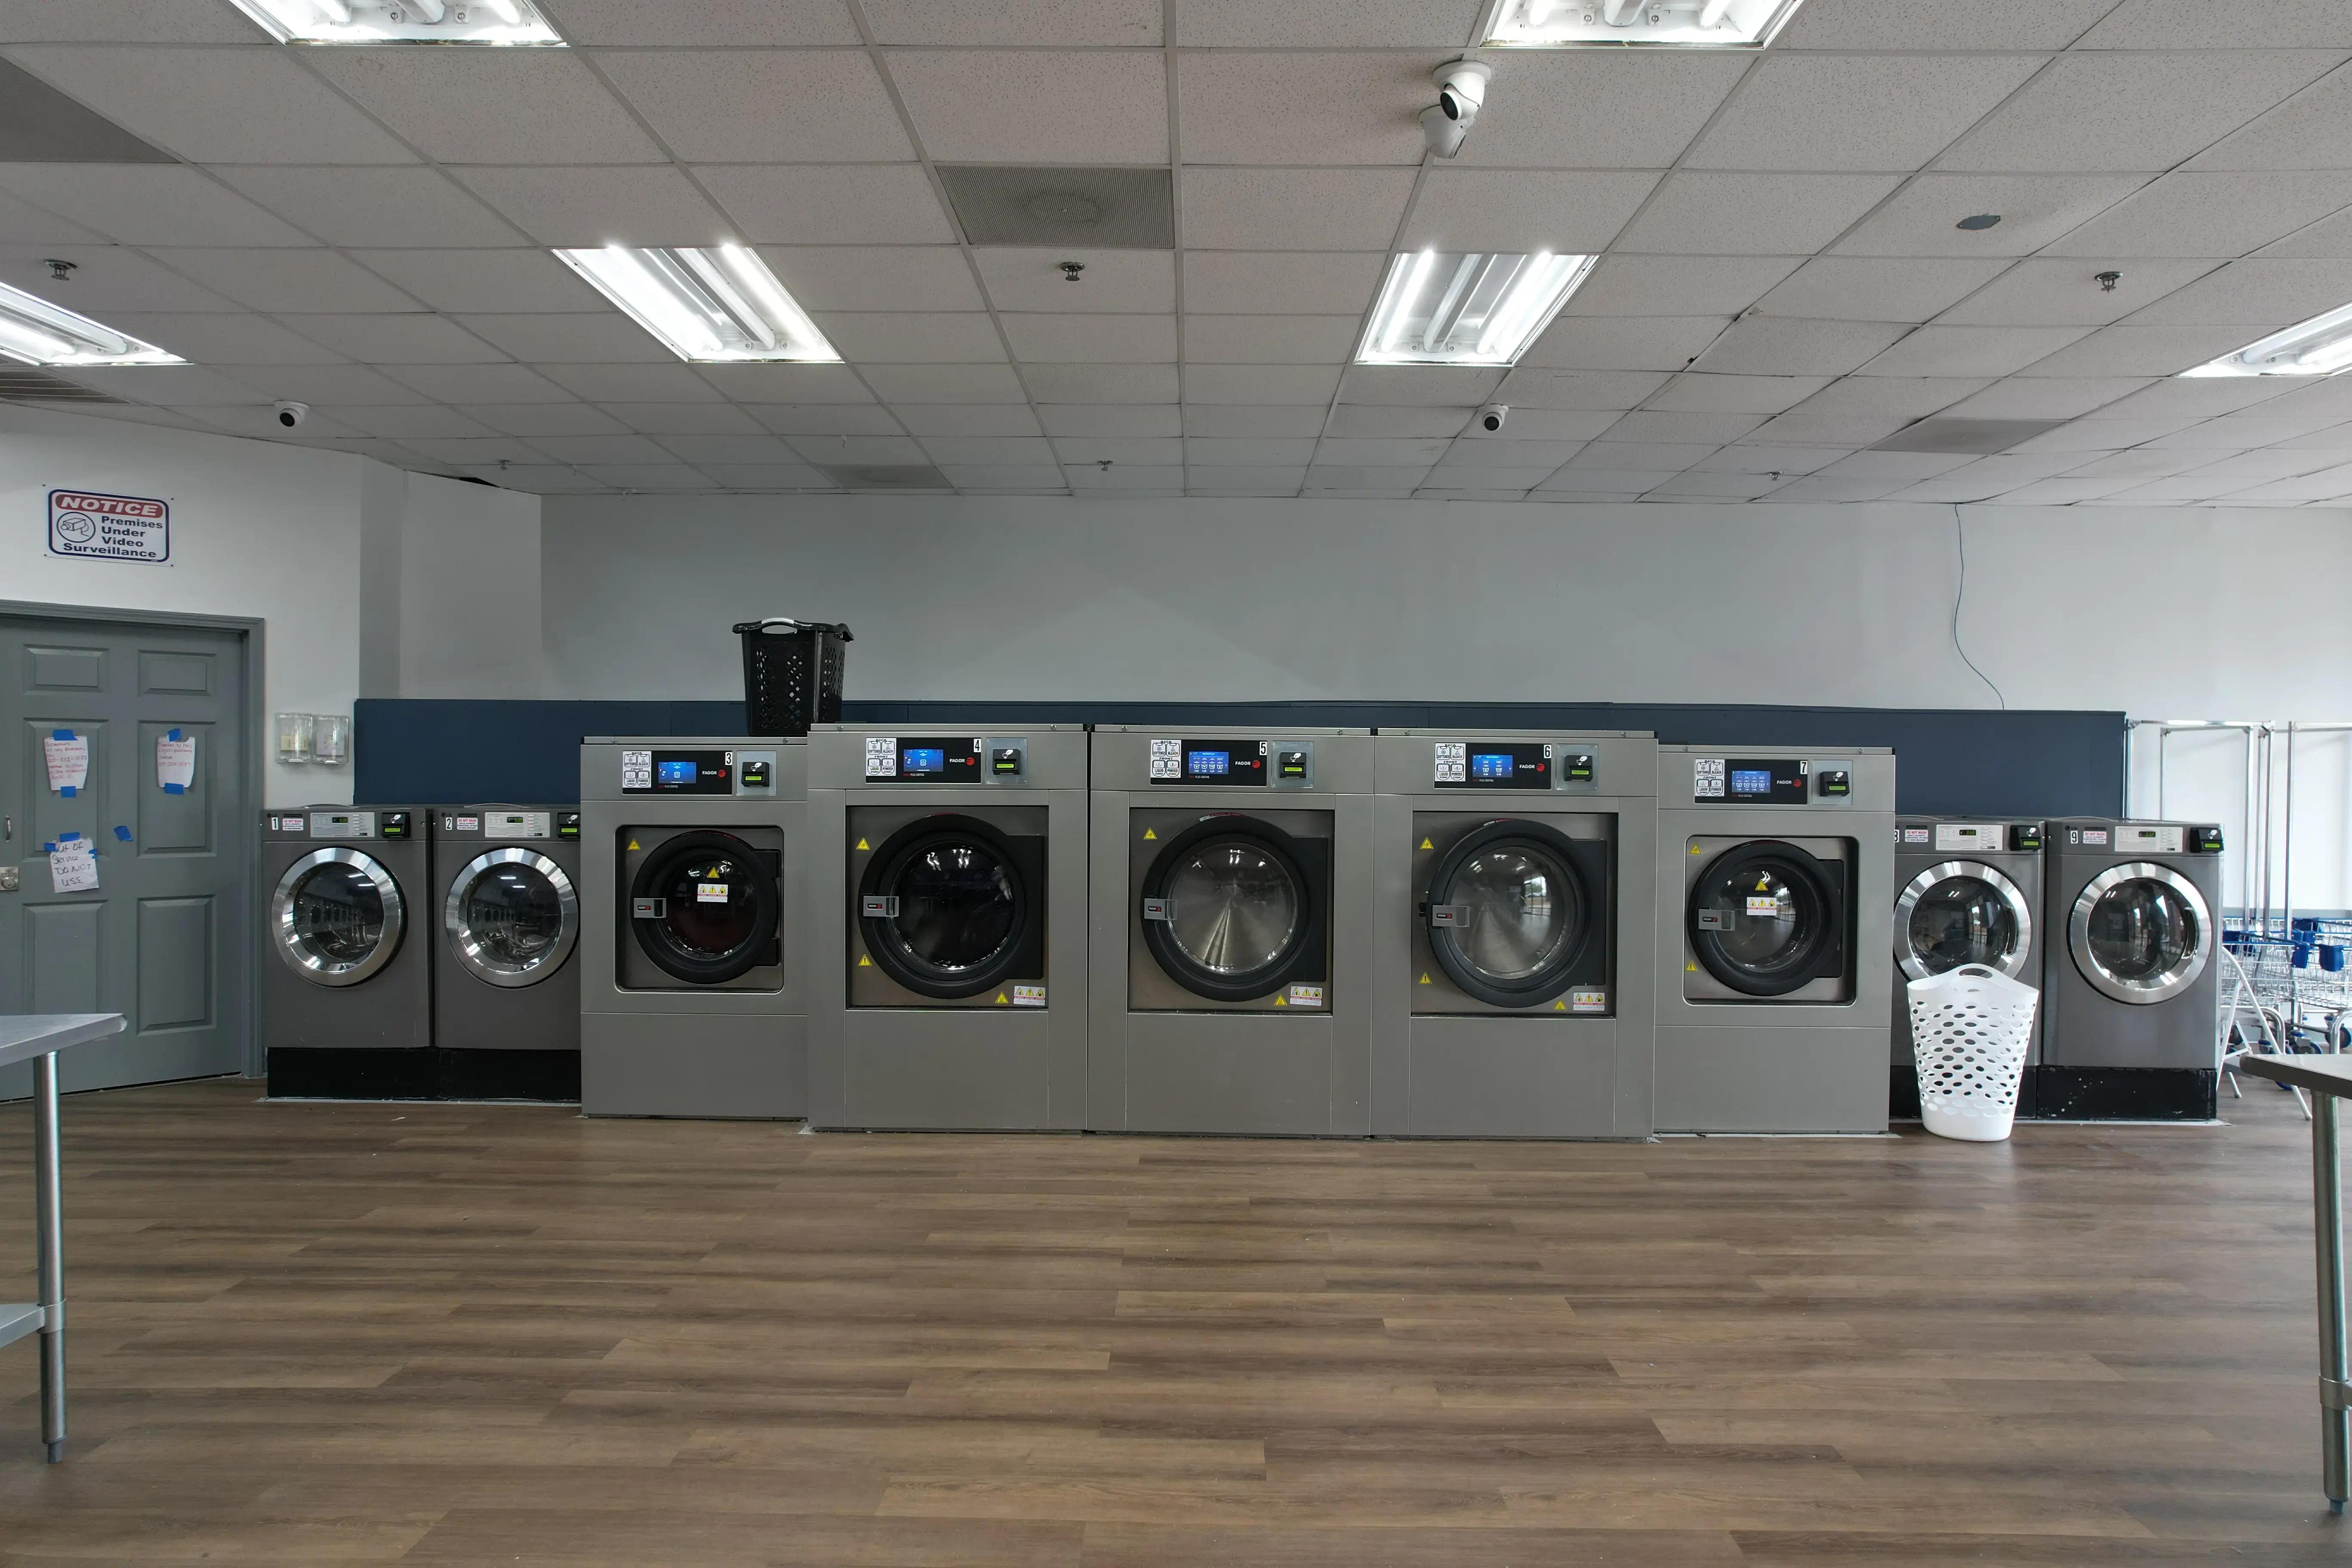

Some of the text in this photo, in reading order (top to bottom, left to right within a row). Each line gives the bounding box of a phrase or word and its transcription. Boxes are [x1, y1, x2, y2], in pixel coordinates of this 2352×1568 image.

[61, 496, 158, 516] NOTICE
[101, 516, 163, 529] Premises
[101, 526, 145, 537] Under
[101, 536, 144, 547] Video
[63, 543, 156, 557] Surveillance
[975, 739, 980, 751] 4
[1261, 743, 1266, 754] 5
[1545, 746, 1550, 757] 6
[726, 753, 731, 764] 3
[1801, 762, 1807, 773] 7
[273, 818, 276, 829] 1
[447, 818, 451, 829] 2
[2072, 832, 2076, 842] 9
[54, 864, 91, 875] DO NOT
[61, 876, 83, 886] USE
